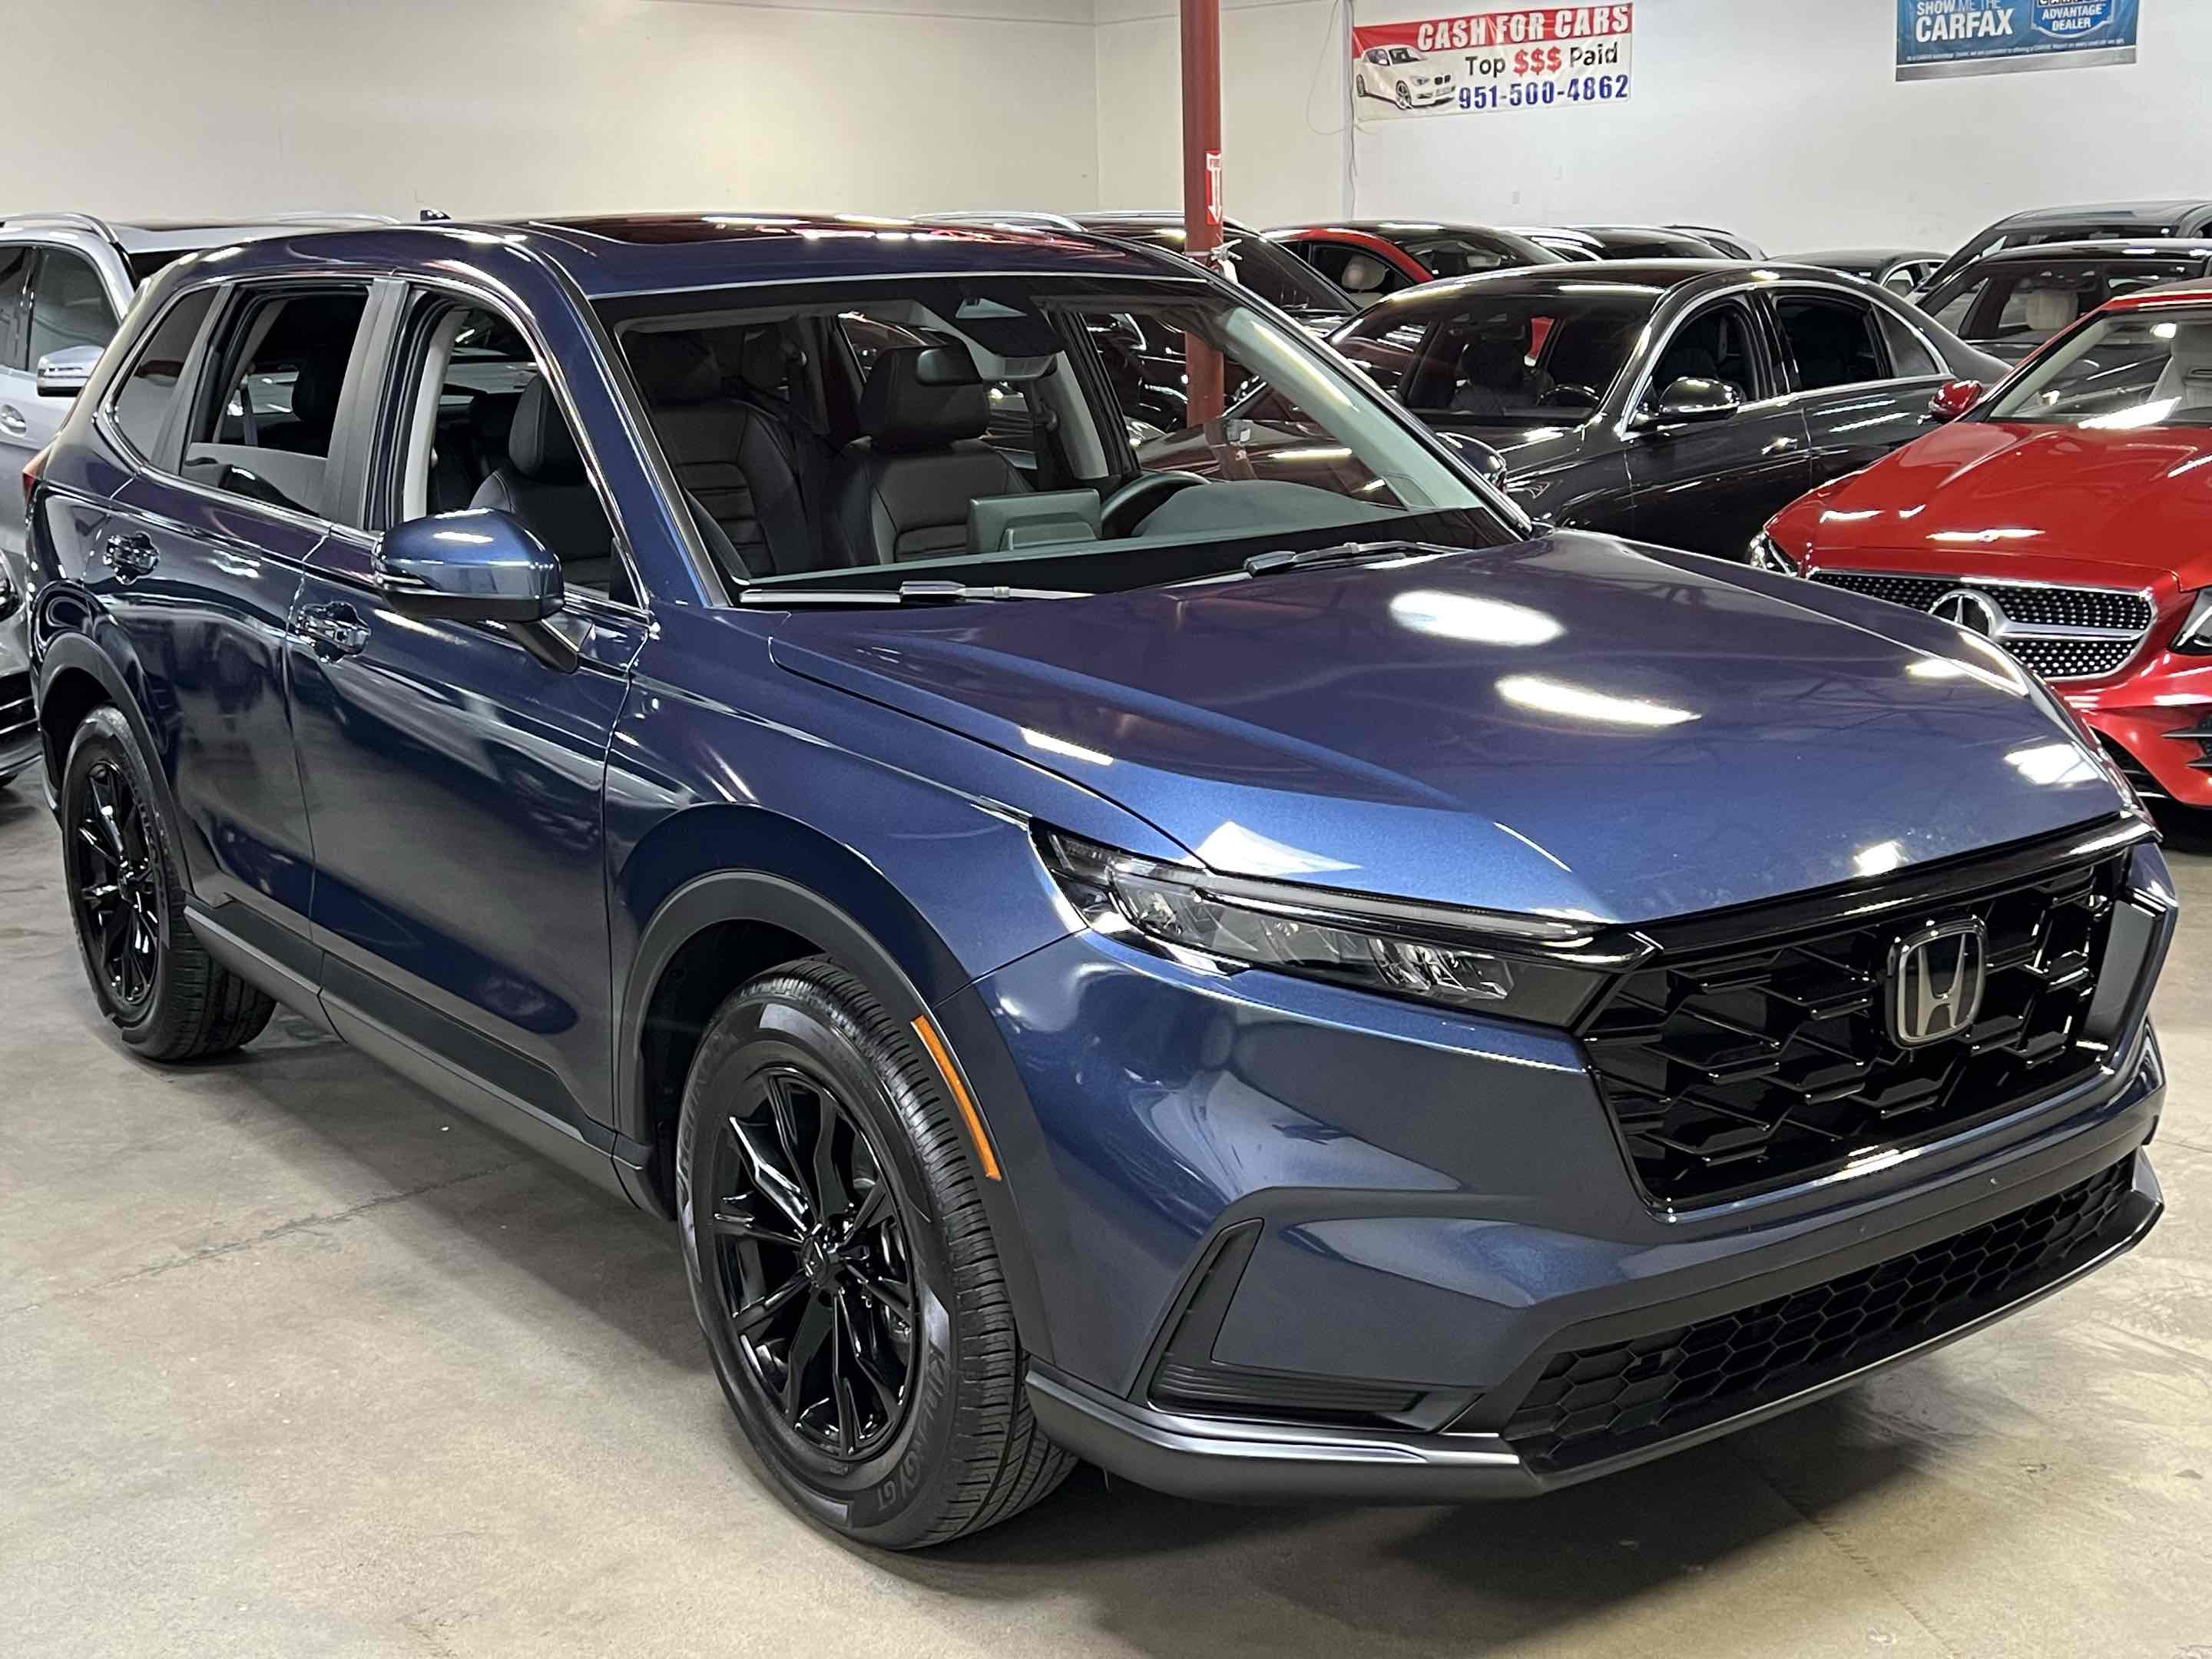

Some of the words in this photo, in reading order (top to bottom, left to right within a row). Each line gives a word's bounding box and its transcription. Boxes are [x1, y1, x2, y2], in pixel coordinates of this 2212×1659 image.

[1916, 0, 1955, 15] SHOW
[1956, 0, 1978, 12] ME
[2041, 4, 2103, 20] ADVANTAGE
[2051, 17, 2091, 31] DEALER
[1417, 17, 1488, 51] CASH
[1497, 12, 1546, 44] FOR
[1554, 5, 1629, 38] CARS
[1916, 8, 2014, 42] CARFAX
[1465, 56, 1506, 78] Top
[1513, 46, 1562, 77] $$$
[1569, 41, 1618, 68] Paid
[1459, 74, 1629, 110] 951-500-4862
